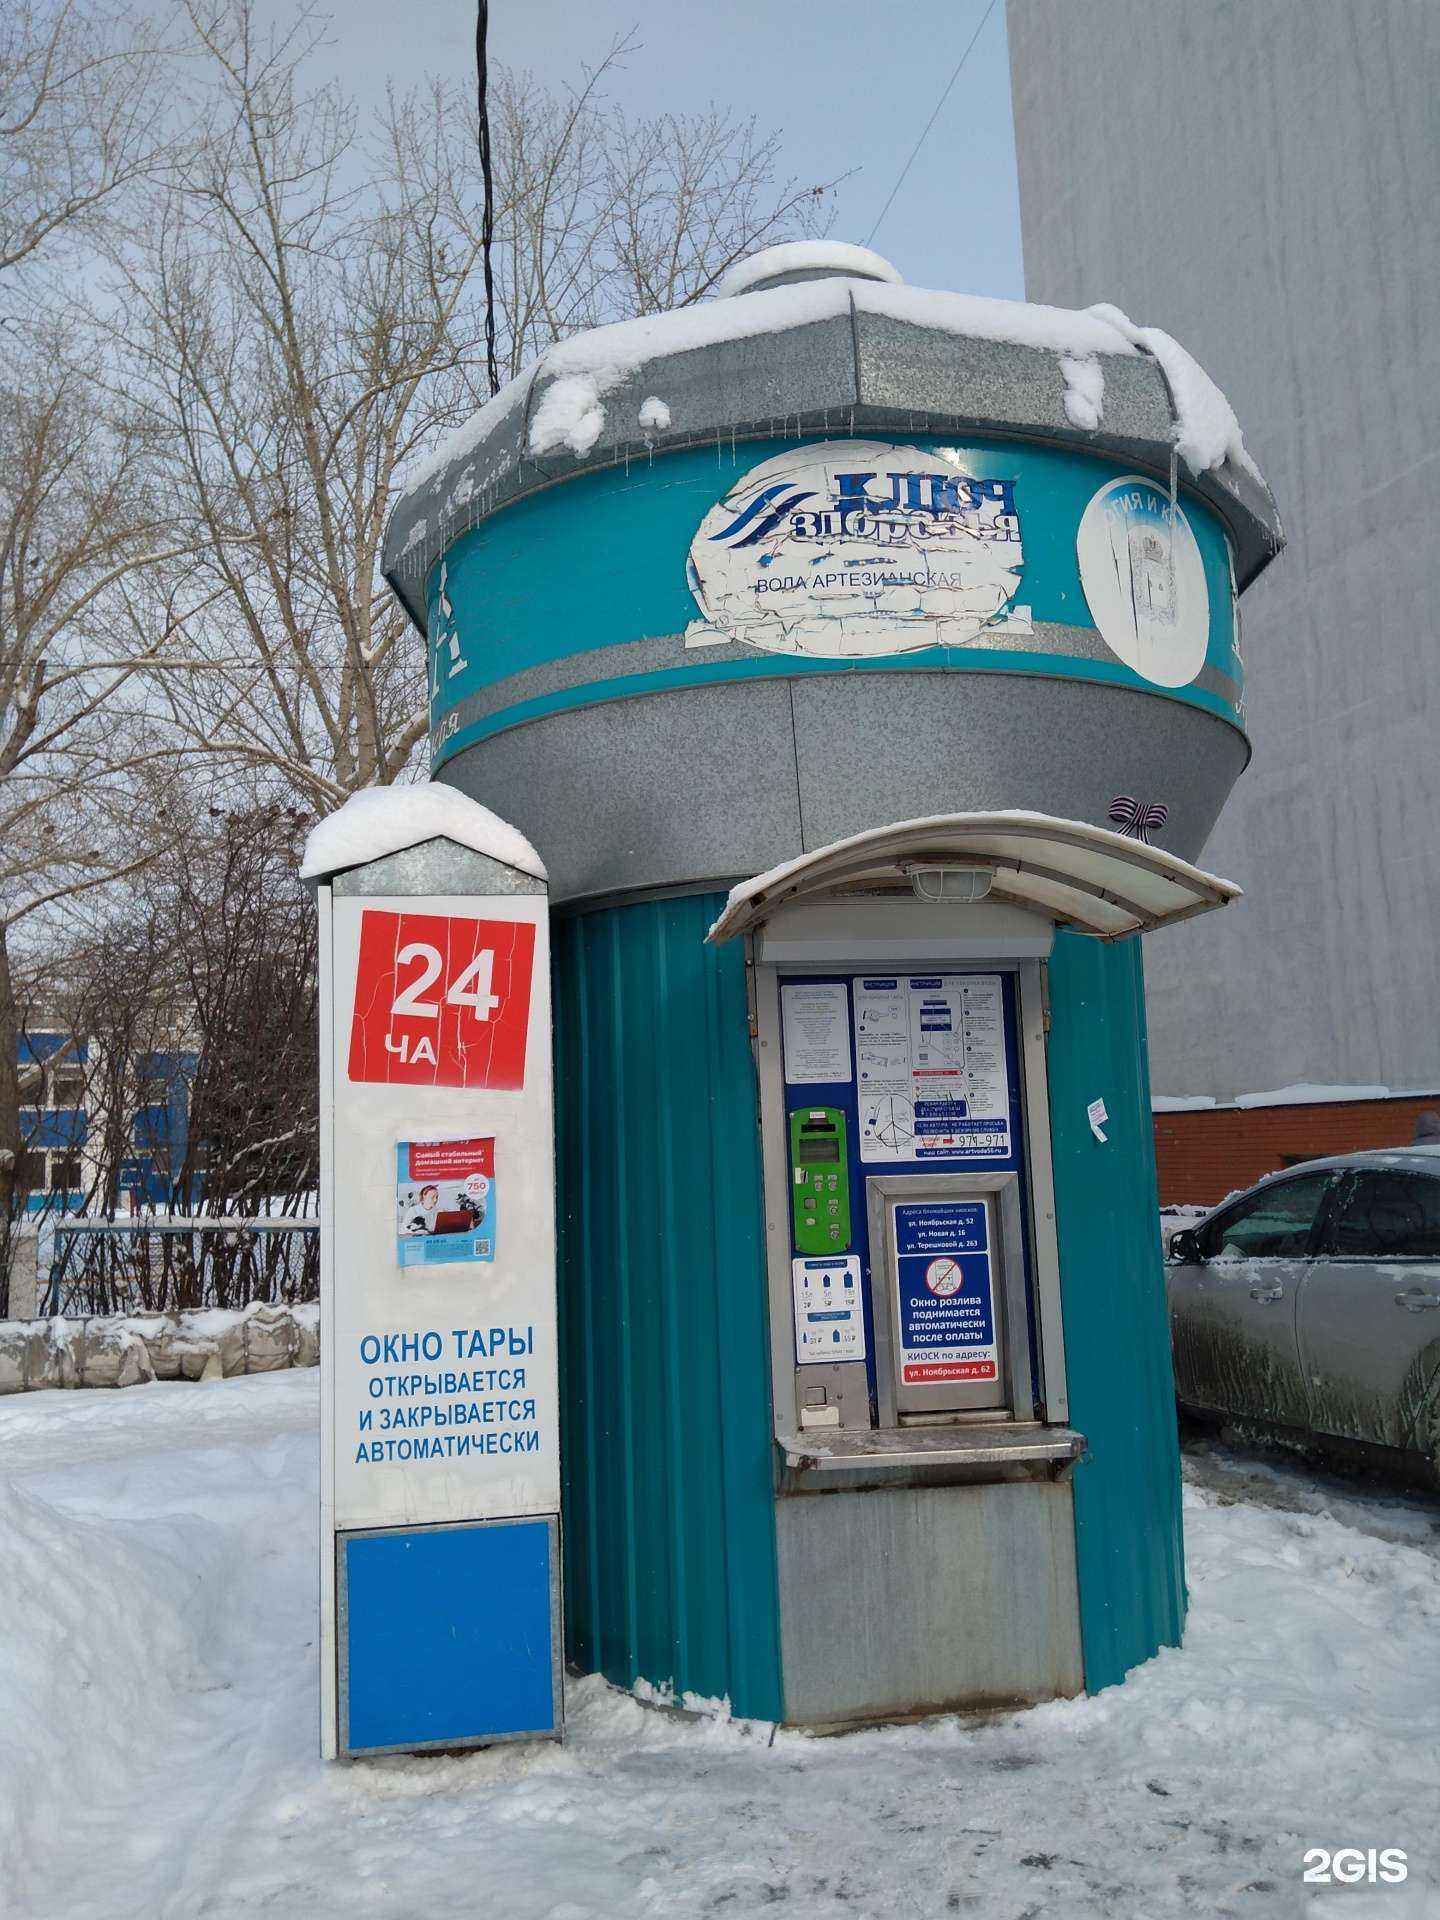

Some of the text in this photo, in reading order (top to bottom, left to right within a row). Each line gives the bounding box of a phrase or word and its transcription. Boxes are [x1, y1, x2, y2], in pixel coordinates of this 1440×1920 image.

[391, 942, 500, 1022] 24
[467, 1182, 486, 1191] 750
[919, 1218, 957, 1228] Ноябрьская
[928, 1230, 948, 1238] Новая
[910, 1296, 981, 1308] Окно розлива
[912, 1308, 981, 1320] поднимается
[908, 1320, 986, 1331] автоматически
[913, 1331, 983, 1343] после оплаты
[360, 1326, 534, 1365] ОКНО ТАРЫ
[907, 1350, 991, 1361] КИОСК по адресу:
[909, 1369, 921, 1378] ул.
[922, 1367, 970, 1377] Ноябрьская
[369, 1368, 526, 1398] ОТКРЫВАЕТСЯ
[359, 1399, 536, 1431] И ЗАКРЫВАЕТСЯ
[355, 1430, 539, 1464] АВТОМАТИЧЕСКИ
